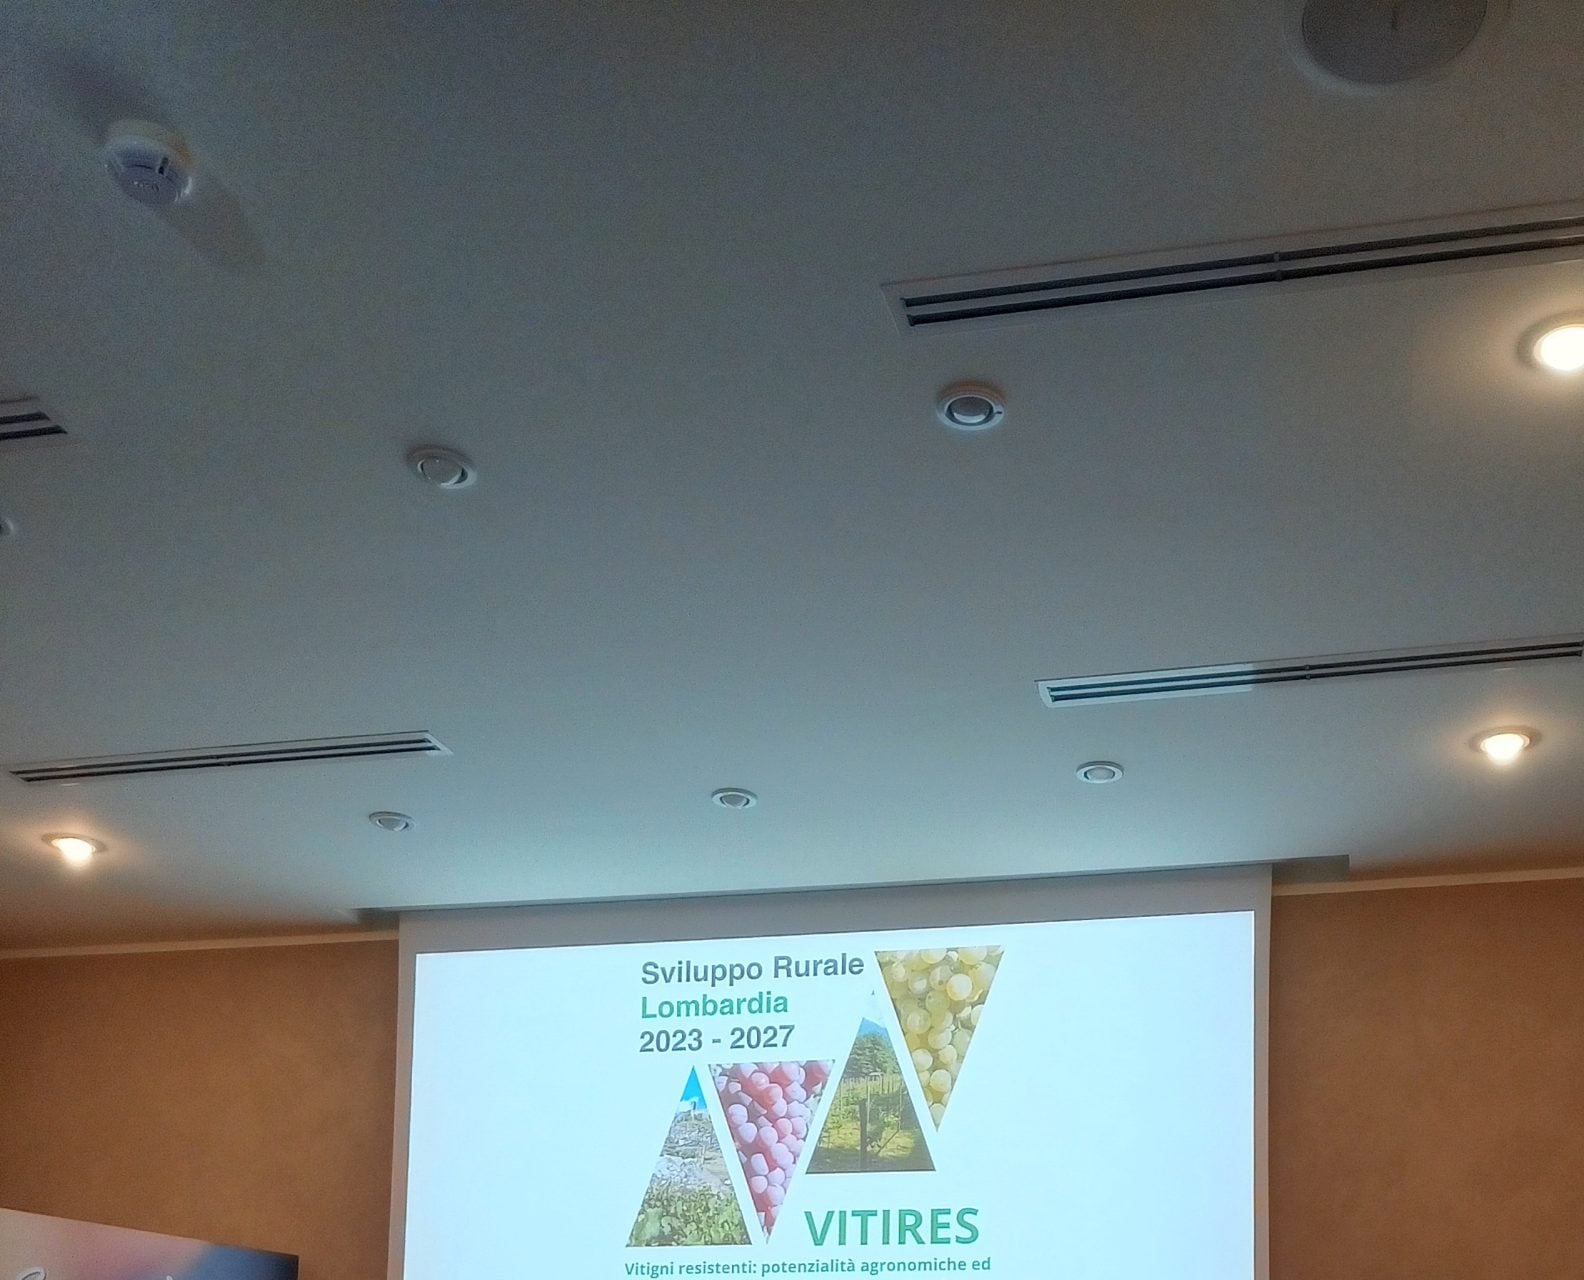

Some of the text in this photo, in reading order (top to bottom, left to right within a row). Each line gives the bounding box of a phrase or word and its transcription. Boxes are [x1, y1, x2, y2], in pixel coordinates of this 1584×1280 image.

[641, 952, 865, 988] Sviluppo Rurale
[641, 991, 789, 1019] Lombardia
[639, 1028, 703, 1053] 2023
[729, 1024, 796, 1050] 2027
[804, 1207, 981, 1247] VITIRES
[625, 1257, 991, 1279] Vitigni resistenti: potenzialità agronomiche ed
